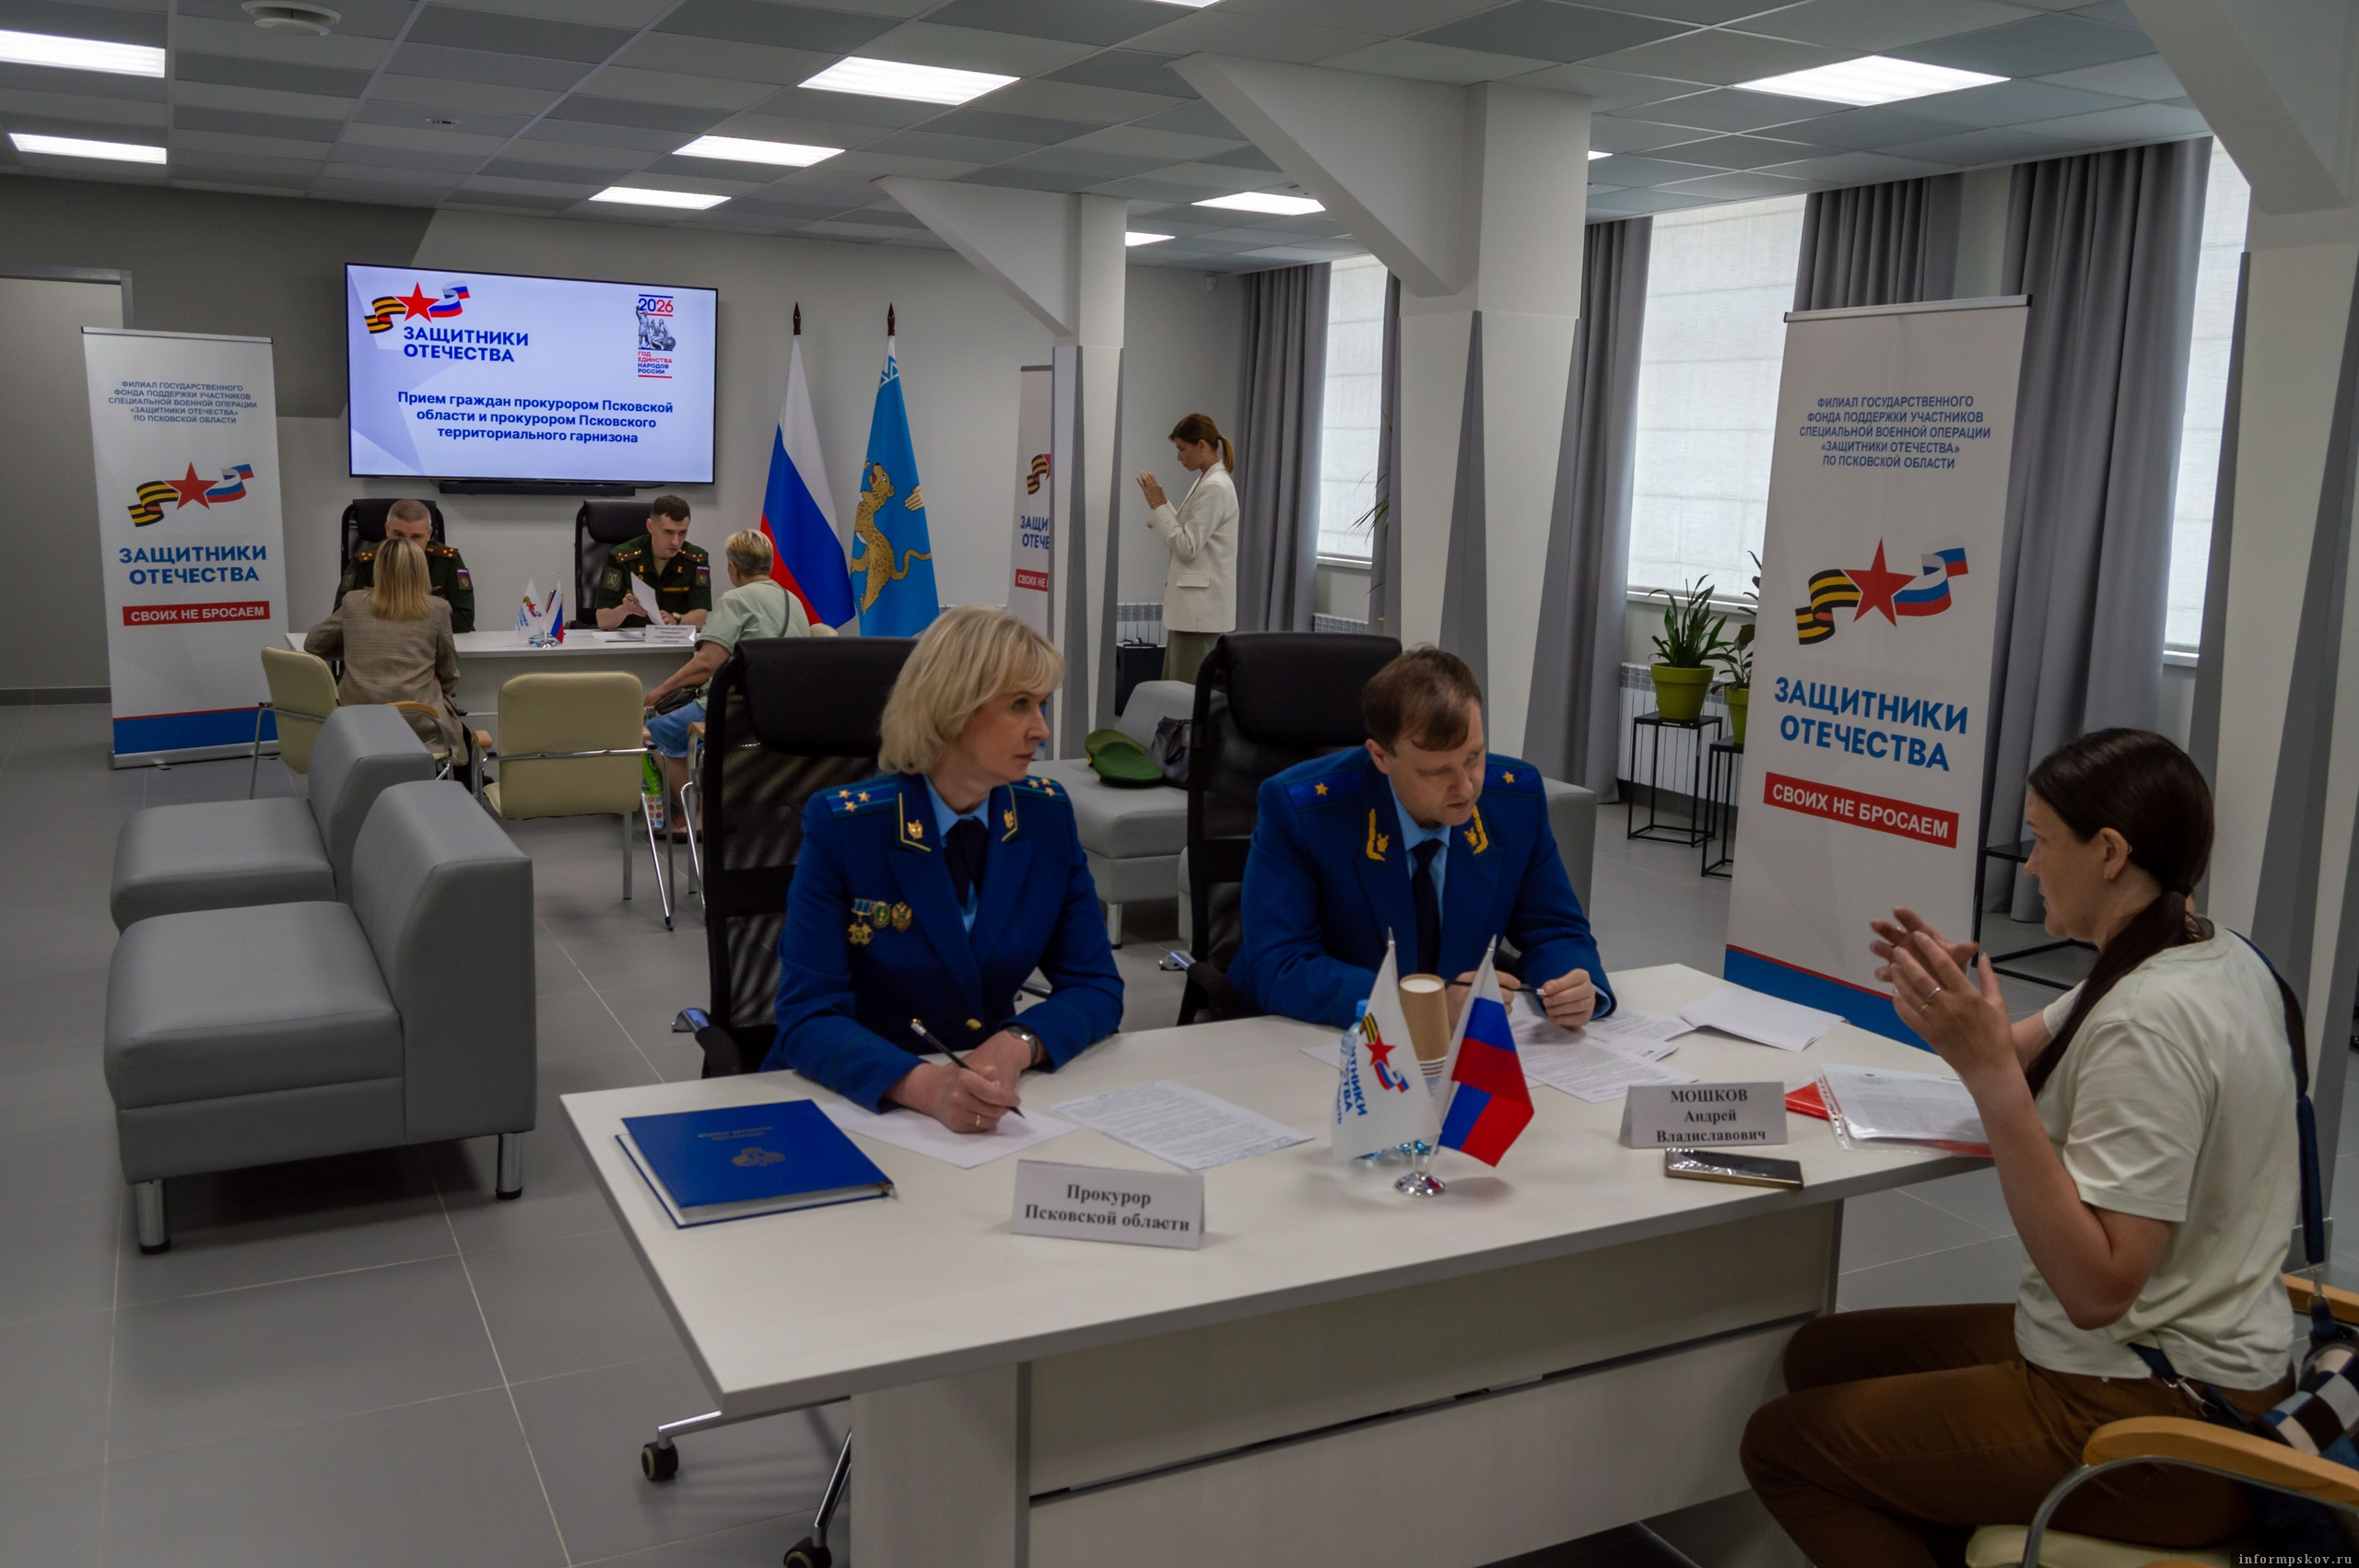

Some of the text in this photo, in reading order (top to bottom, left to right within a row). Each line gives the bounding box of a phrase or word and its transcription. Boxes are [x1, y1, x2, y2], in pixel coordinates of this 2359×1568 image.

[639, 298, 674, 312] 2026
[404, 326, 529, 346] ЗАЩИТНИКИ
[404, 344, 514, 362] ОТЕЧЕСТВА
[159, 382, 243, 392] ГОСУДАРСТВЕННОГО
[108, 397, 171, 405] СПЕЦИАЛЬНОЙ
[398, 392, 673, 413] Прием граждан прокурором Псковской
[1817, 395, 1974, 409] ФИЛИАЛ ГОСУДАРСТВЕННОГО
[417, 409, 656, 427] области и прокурором Псковского
[1807, 411, 1984, 424] ФОНДА ПОДДЕРЖКИ УЧАСТНИКОВ
[437, 428, 639, 443] территориального гарнизона
[1800, 425, 1990, 440] СПЕЦИАЛЬНОЙ ВОЕННОЙ ОПЕРАЦИИ
[1821, 440, 1960, 453] «ЗАЩИТНИКИ ОТЕЧЕСТВА»
[1823, 454, 1955, 469] ПО ПСКОВСКОЙ ОБЛАСТИ
[1020, 515, 1050, 532] ЗАЩИ
[119, 545, 266, 564] ЗАЩИТНИКИ
[129, 566, 260, 585] ОТЕЧЕСТВА
[1017, 574, 1037, 587] СВОИХ
[1038, 578, 1046, 588] НЕ
[131, 606, 264, 622] СВОИХ НЕ БРОСАЕМ
[1774, 677, 1968, 734] ЗАЩИТНИКИ
[1780, 715, 1950, 772] ОТЕЧЕСТВА
[1773, 784, 1949, 838] СВОИХ НЕ БРОСАЕМ
[1670, 1089, 1748, 1103] МОШКОВ
[1684, 1109, 1737, 1125] Андрей
[1656, 1129, 1766, 1143] Владиславович
[1066, 1184, 1152, 1209] Прокурор
[1025, 1204, 1191, 1232] Псковской области
